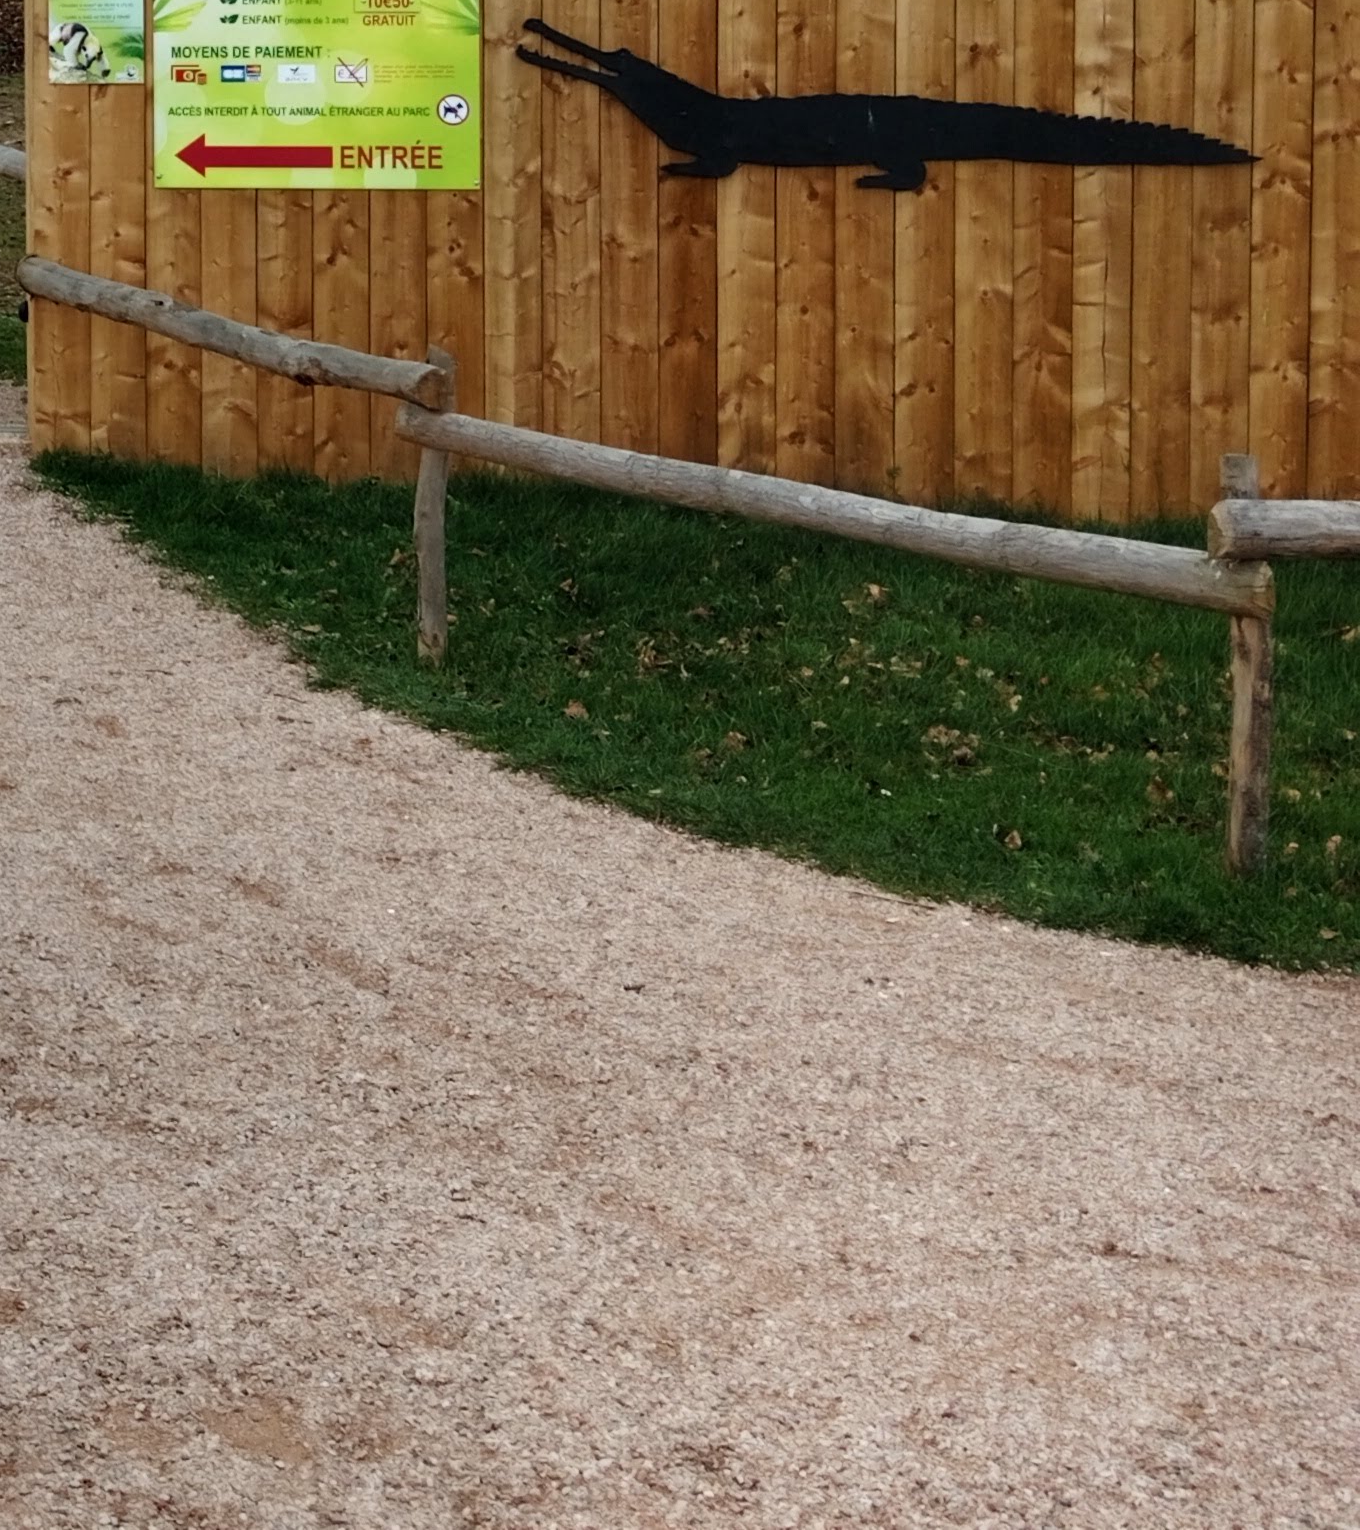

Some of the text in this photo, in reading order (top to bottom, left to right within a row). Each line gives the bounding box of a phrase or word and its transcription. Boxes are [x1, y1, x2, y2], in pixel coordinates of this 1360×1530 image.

[242, 15, 282, 24] ENFANT
[362, 15, 416, 26] GRATUIT
[171, 46, 229, 59] MOYENS
[232, 46, 250, 58] DE
[254, 46, 322, 58] PAIEMENT
[168, 104, 430, 117] ACCÈS INTERDIT À TOUT ANIMAL ÉTRANGER AU PARC
[340, 140, 443, 169] ENTRÉE
